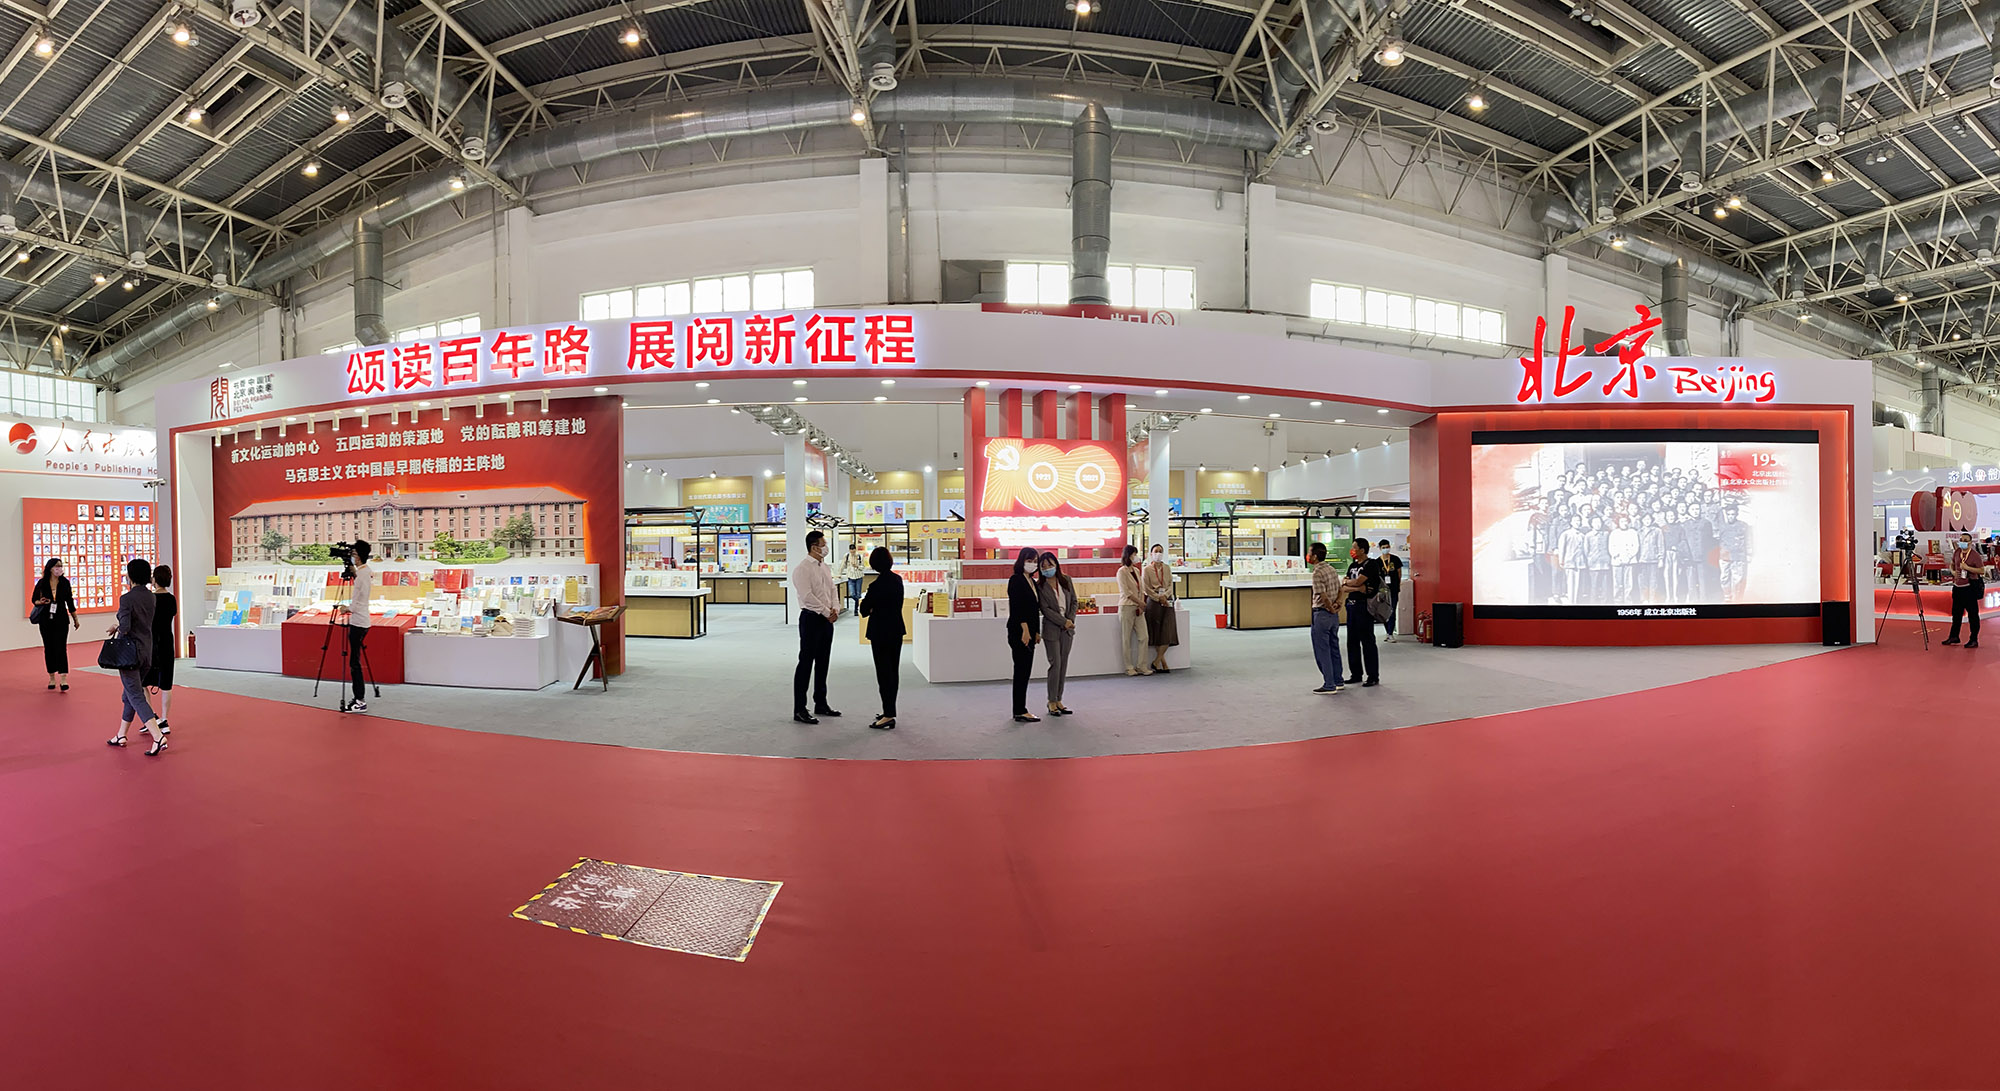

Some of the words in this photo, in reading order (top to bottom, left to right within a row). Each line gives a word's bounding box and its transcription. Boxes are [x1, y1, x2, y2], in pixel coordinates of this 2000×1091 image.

[346, 324, 591, 395] 颂读百年路
[626, 313, 917, 371] 展阅新征程
[1517, 304, 1663, 403] 北京
[1667, 365, 1777, 403] Beijing
[336, 427, 444, 453] 五四运动的策源地
[460, 417, 587, 442] 党的酝酿和筹建地
[45, 460, 89, 471] People's
[95, 463, 142, 475] Publishing
[285, 453, 505, 483] 马克思主义在中国最早期传播的主阵地
[1035, 473, 1051, 481] 1921
